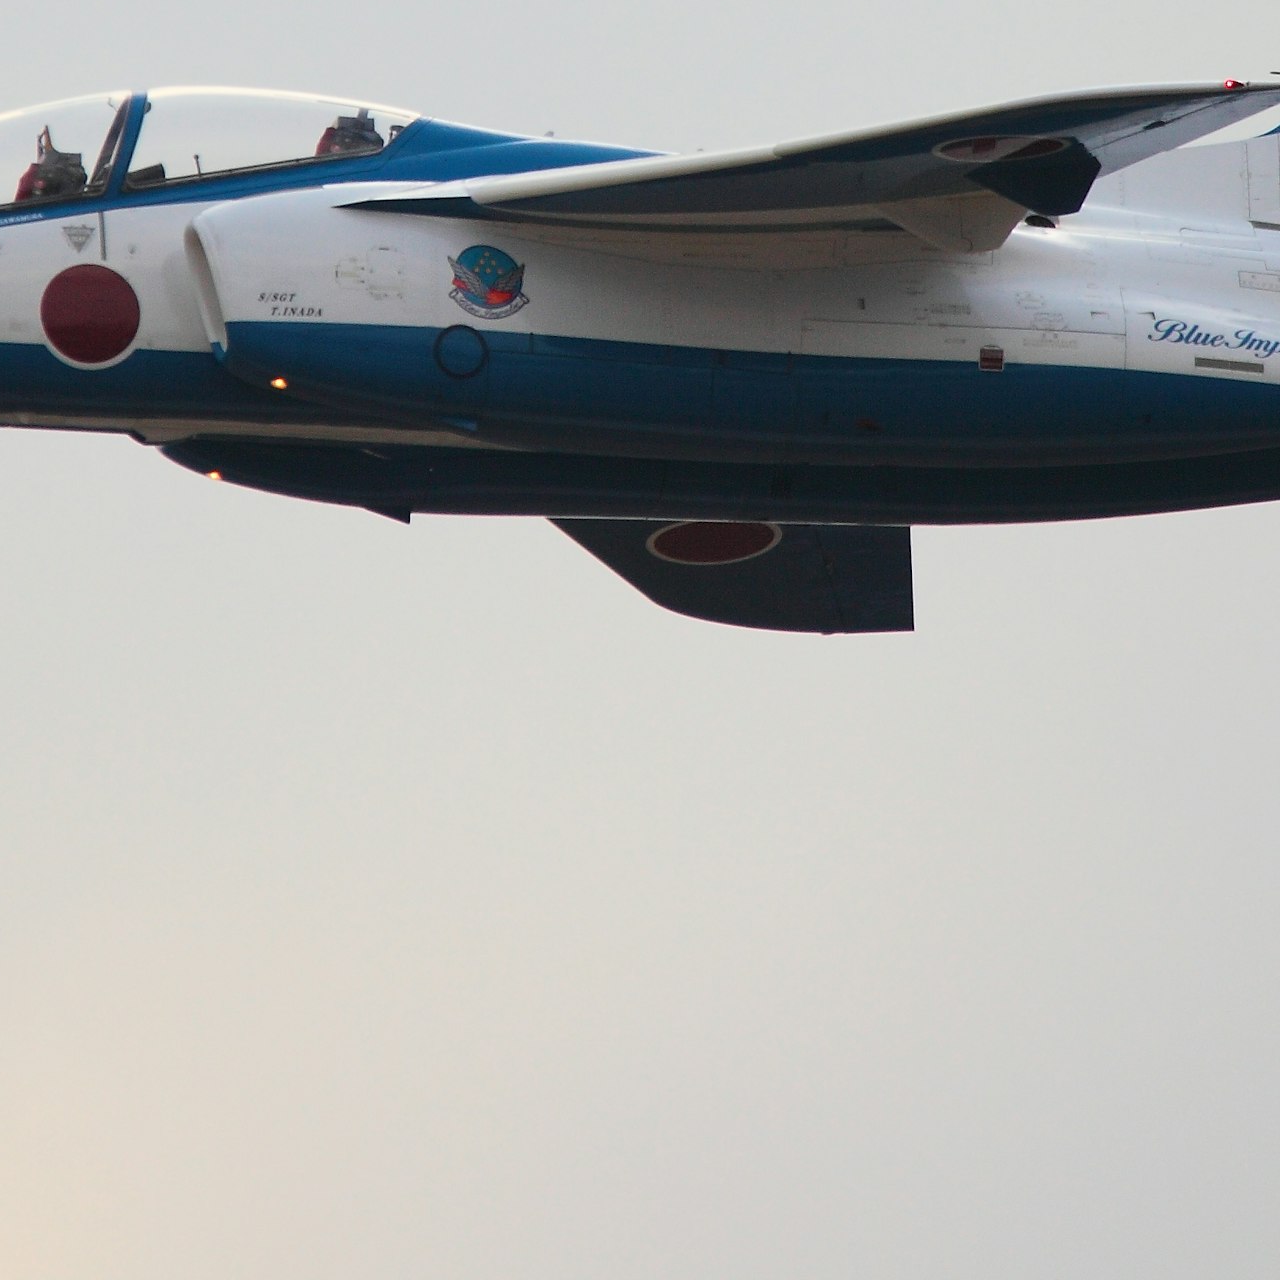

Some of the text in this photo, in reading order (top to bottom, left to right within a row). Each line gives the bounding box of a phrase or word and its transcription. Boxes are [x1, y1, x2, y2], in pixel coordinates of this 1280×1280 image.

[258, 292, 296, 303] S/SGT
[270, 307, 322, 317] T.INADA
[1148, 319, 1224, 347] Blue
